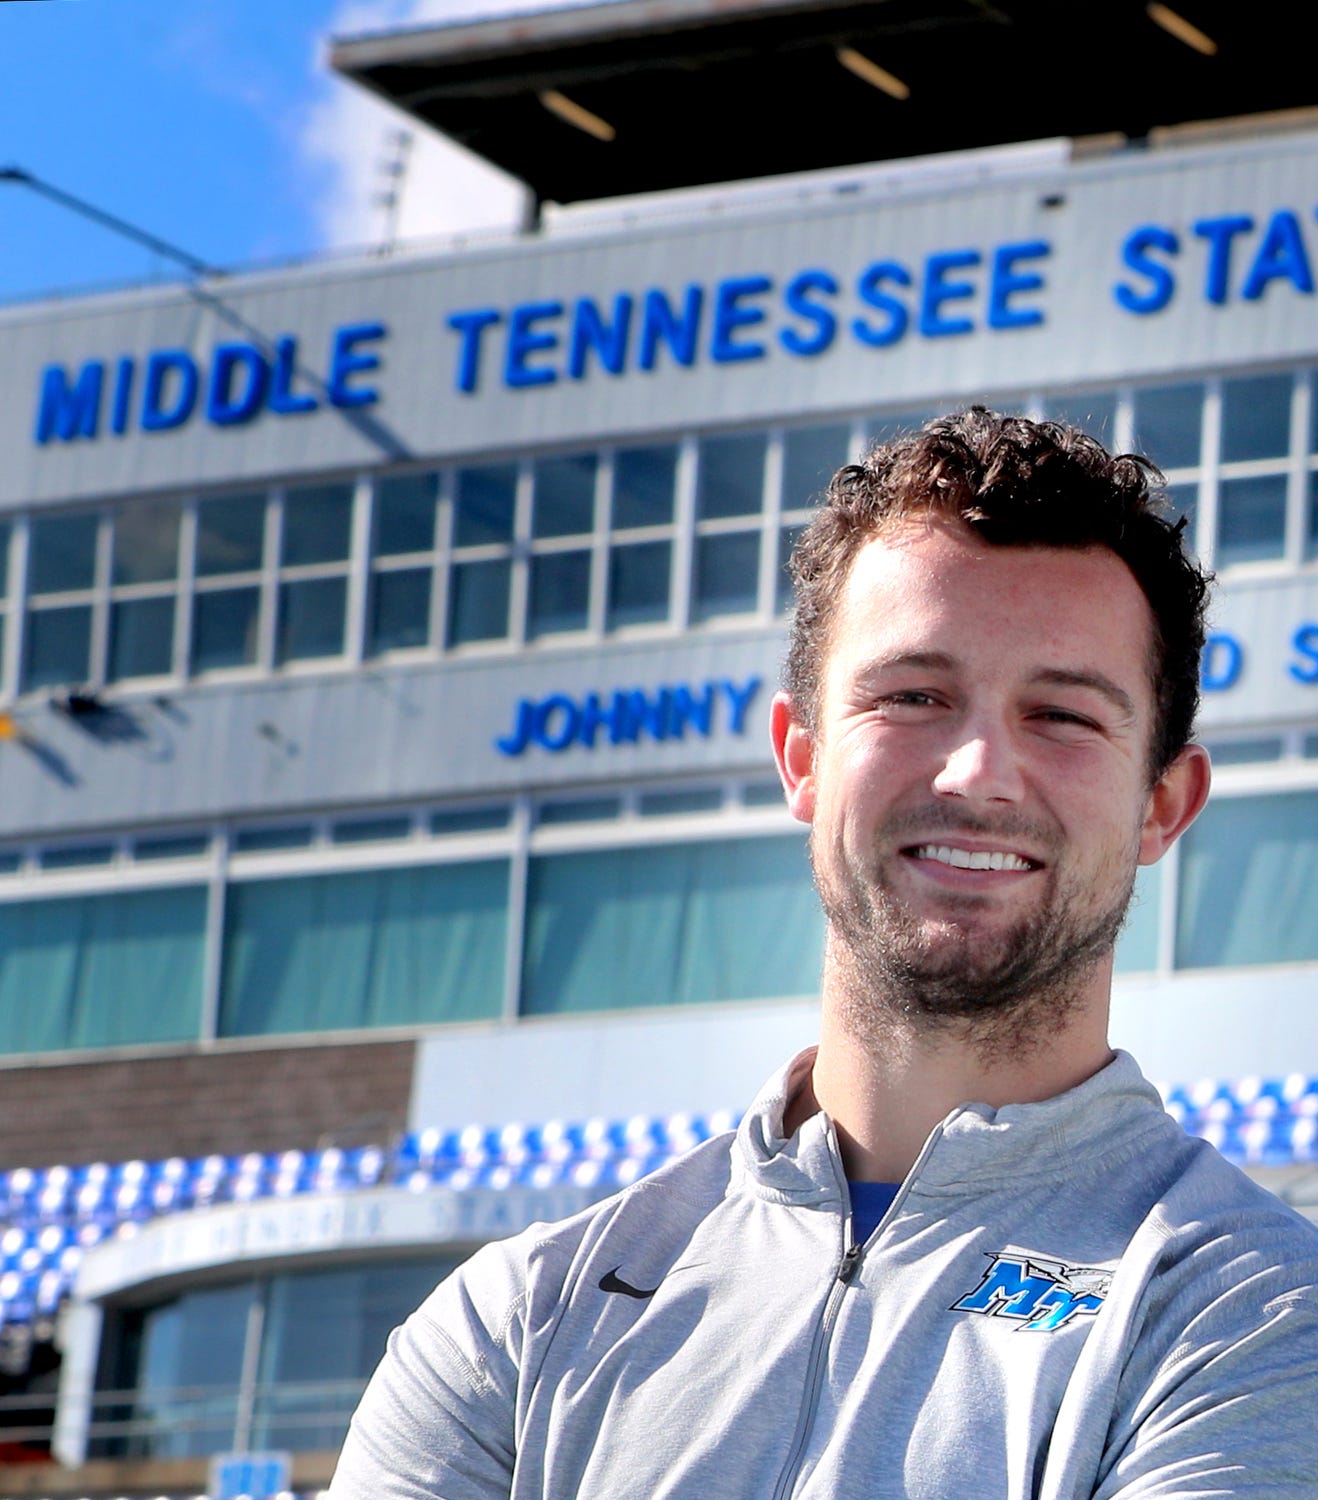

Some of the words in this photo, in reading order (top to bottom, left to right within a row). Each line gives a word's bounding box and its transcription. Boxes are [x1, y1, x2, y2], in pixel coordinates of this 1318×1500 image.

[35, 320, 387, 445] MIDDLE
[446, 239, 1052, 394] TENNESSEE
[495, 674, 763, 757] JOHNNY
[948, 1256, 1106, 1332] MT
